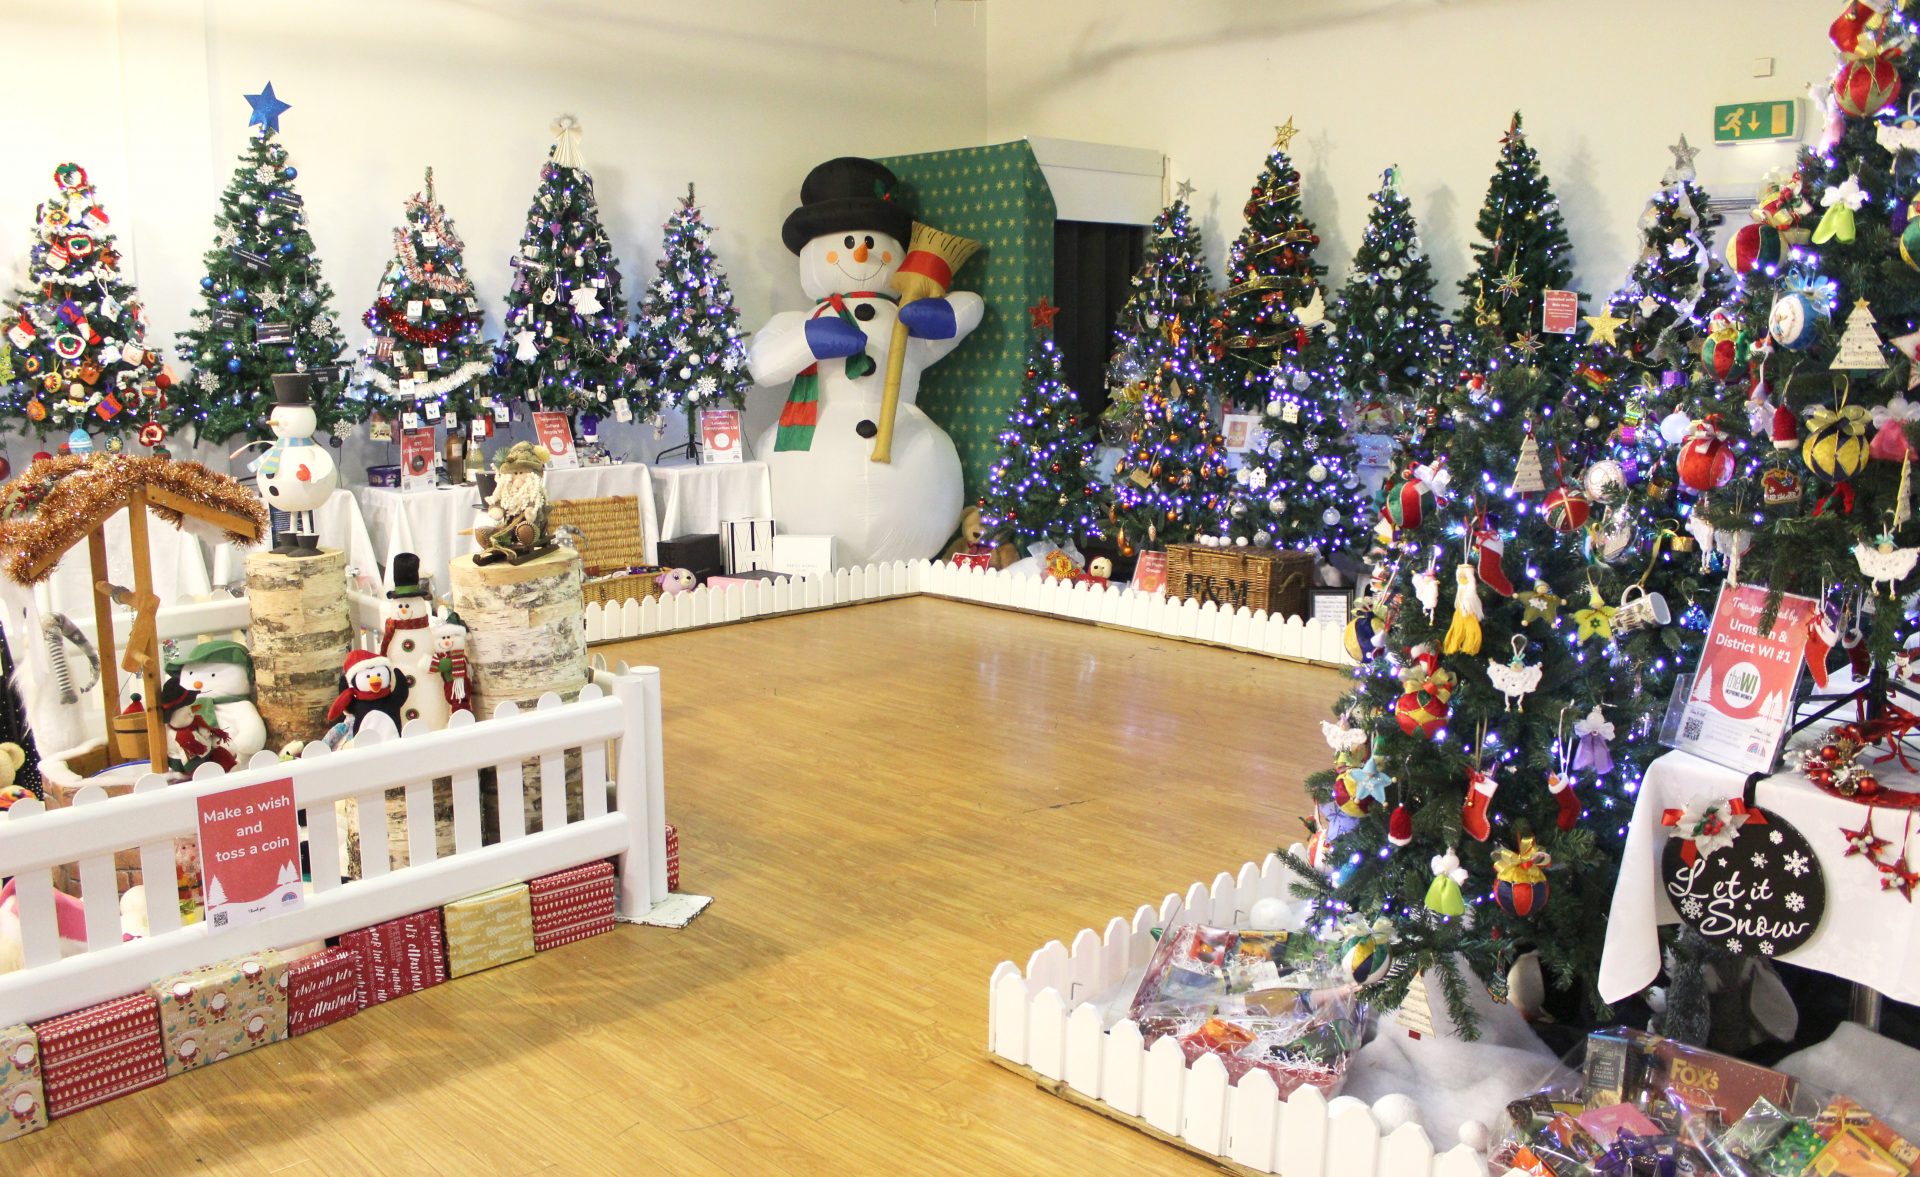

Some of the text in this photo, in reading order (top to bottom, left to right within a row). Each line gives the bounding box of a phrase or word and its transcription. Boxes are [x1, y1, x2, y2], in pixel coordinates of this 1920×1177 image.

[1789, 609, 1799, 627] by
[1715, 633, 1791, 664] District WI #1
[1778, 630, 1788, 643] &
[203, 795, 290, 824] Make a wish
[236, 821, 263, 837] and
[215, 836, 290, 862] toss a coin
[1668, 858, 1773, 900] Let it
[1700, 899, 1810, 939] Snow
